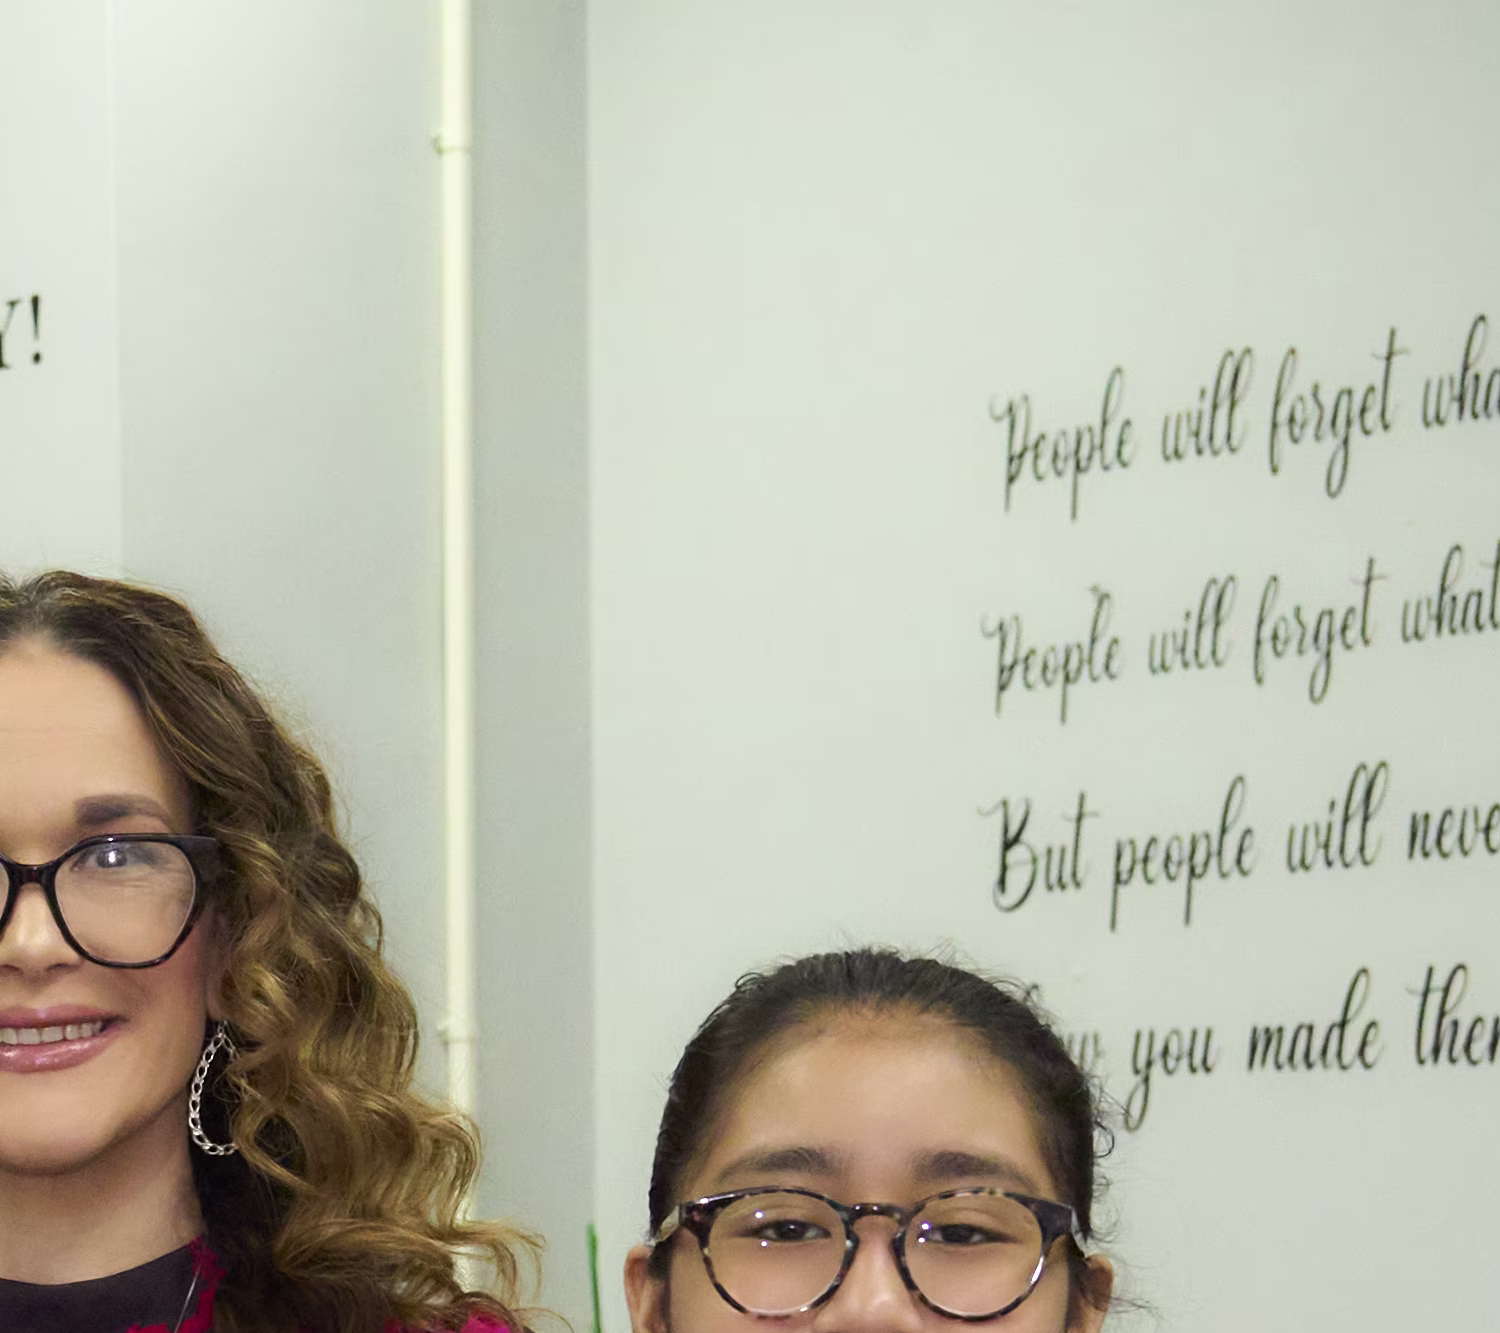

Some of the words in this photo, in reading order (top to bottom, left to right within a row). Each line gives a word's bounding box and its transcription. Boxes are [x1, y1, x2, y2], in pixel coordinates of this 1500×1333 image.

[990, 366, 1135, 521] People
[1162, 347, 1254, 463] will
[1270, 327, 1410, 498] forget
[981, 584, 1123, 725] People
[1149, 575, 1239, 675] will
[1254, 556, 1388, 704] forget
[977, 791, 1099, 913] But
[1111, 775, 1256, 932] people
[1287, 760, 1388, 873] will
[1124, 1027, 1219, 1132] you
[1248, 967, 1384, 1071] made
